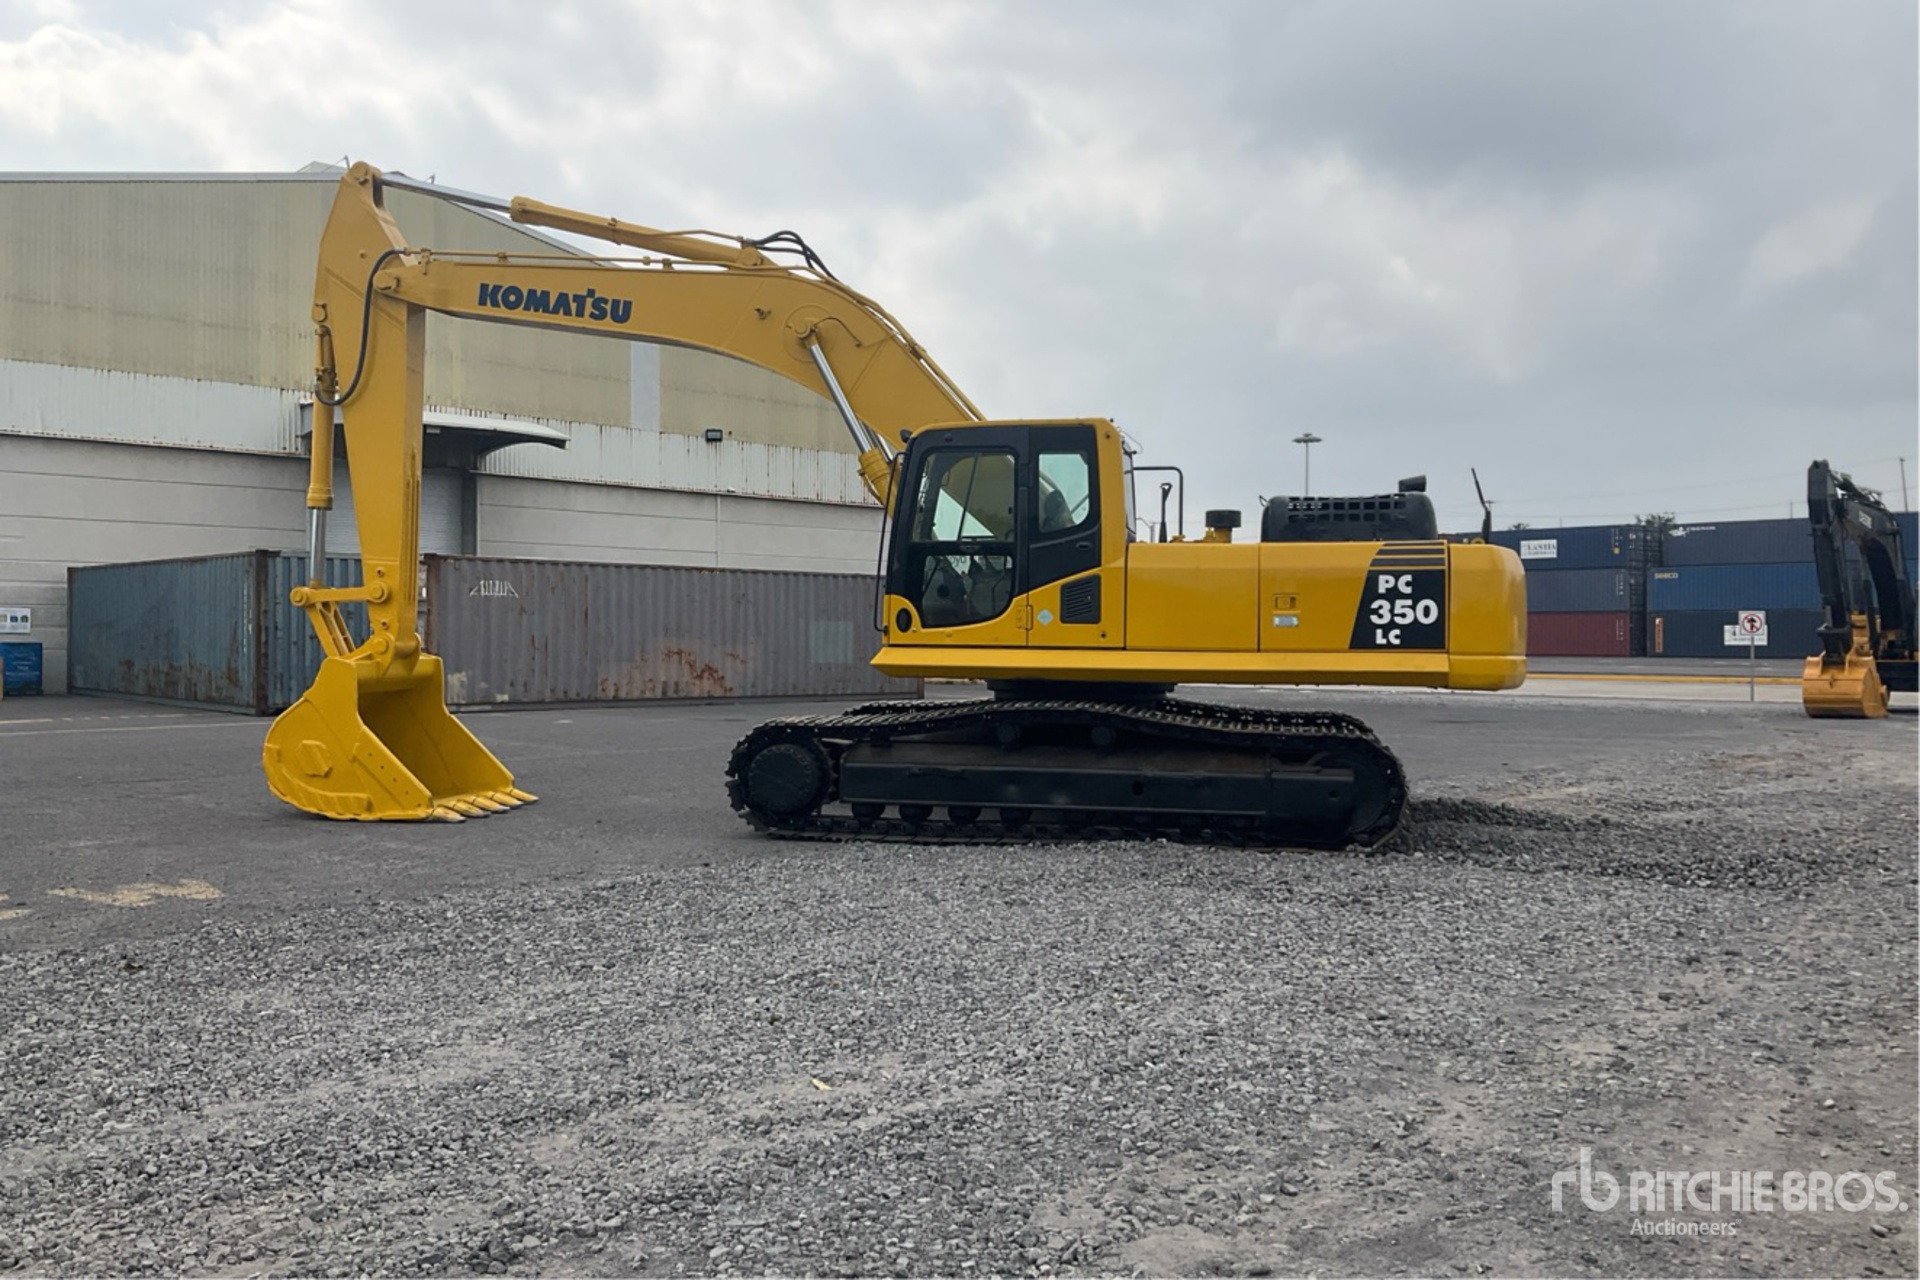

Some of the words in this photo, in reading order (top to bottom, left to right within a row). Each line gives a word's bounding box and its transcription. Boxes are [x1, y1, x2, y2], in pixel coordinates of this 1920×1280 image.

[478, 283, 632, 323] KOMATSU
[1377, 574, 1412, 594] PC
[1369, 598, 1439, 625] 350
[1375, 628, 1401, 645] LC
